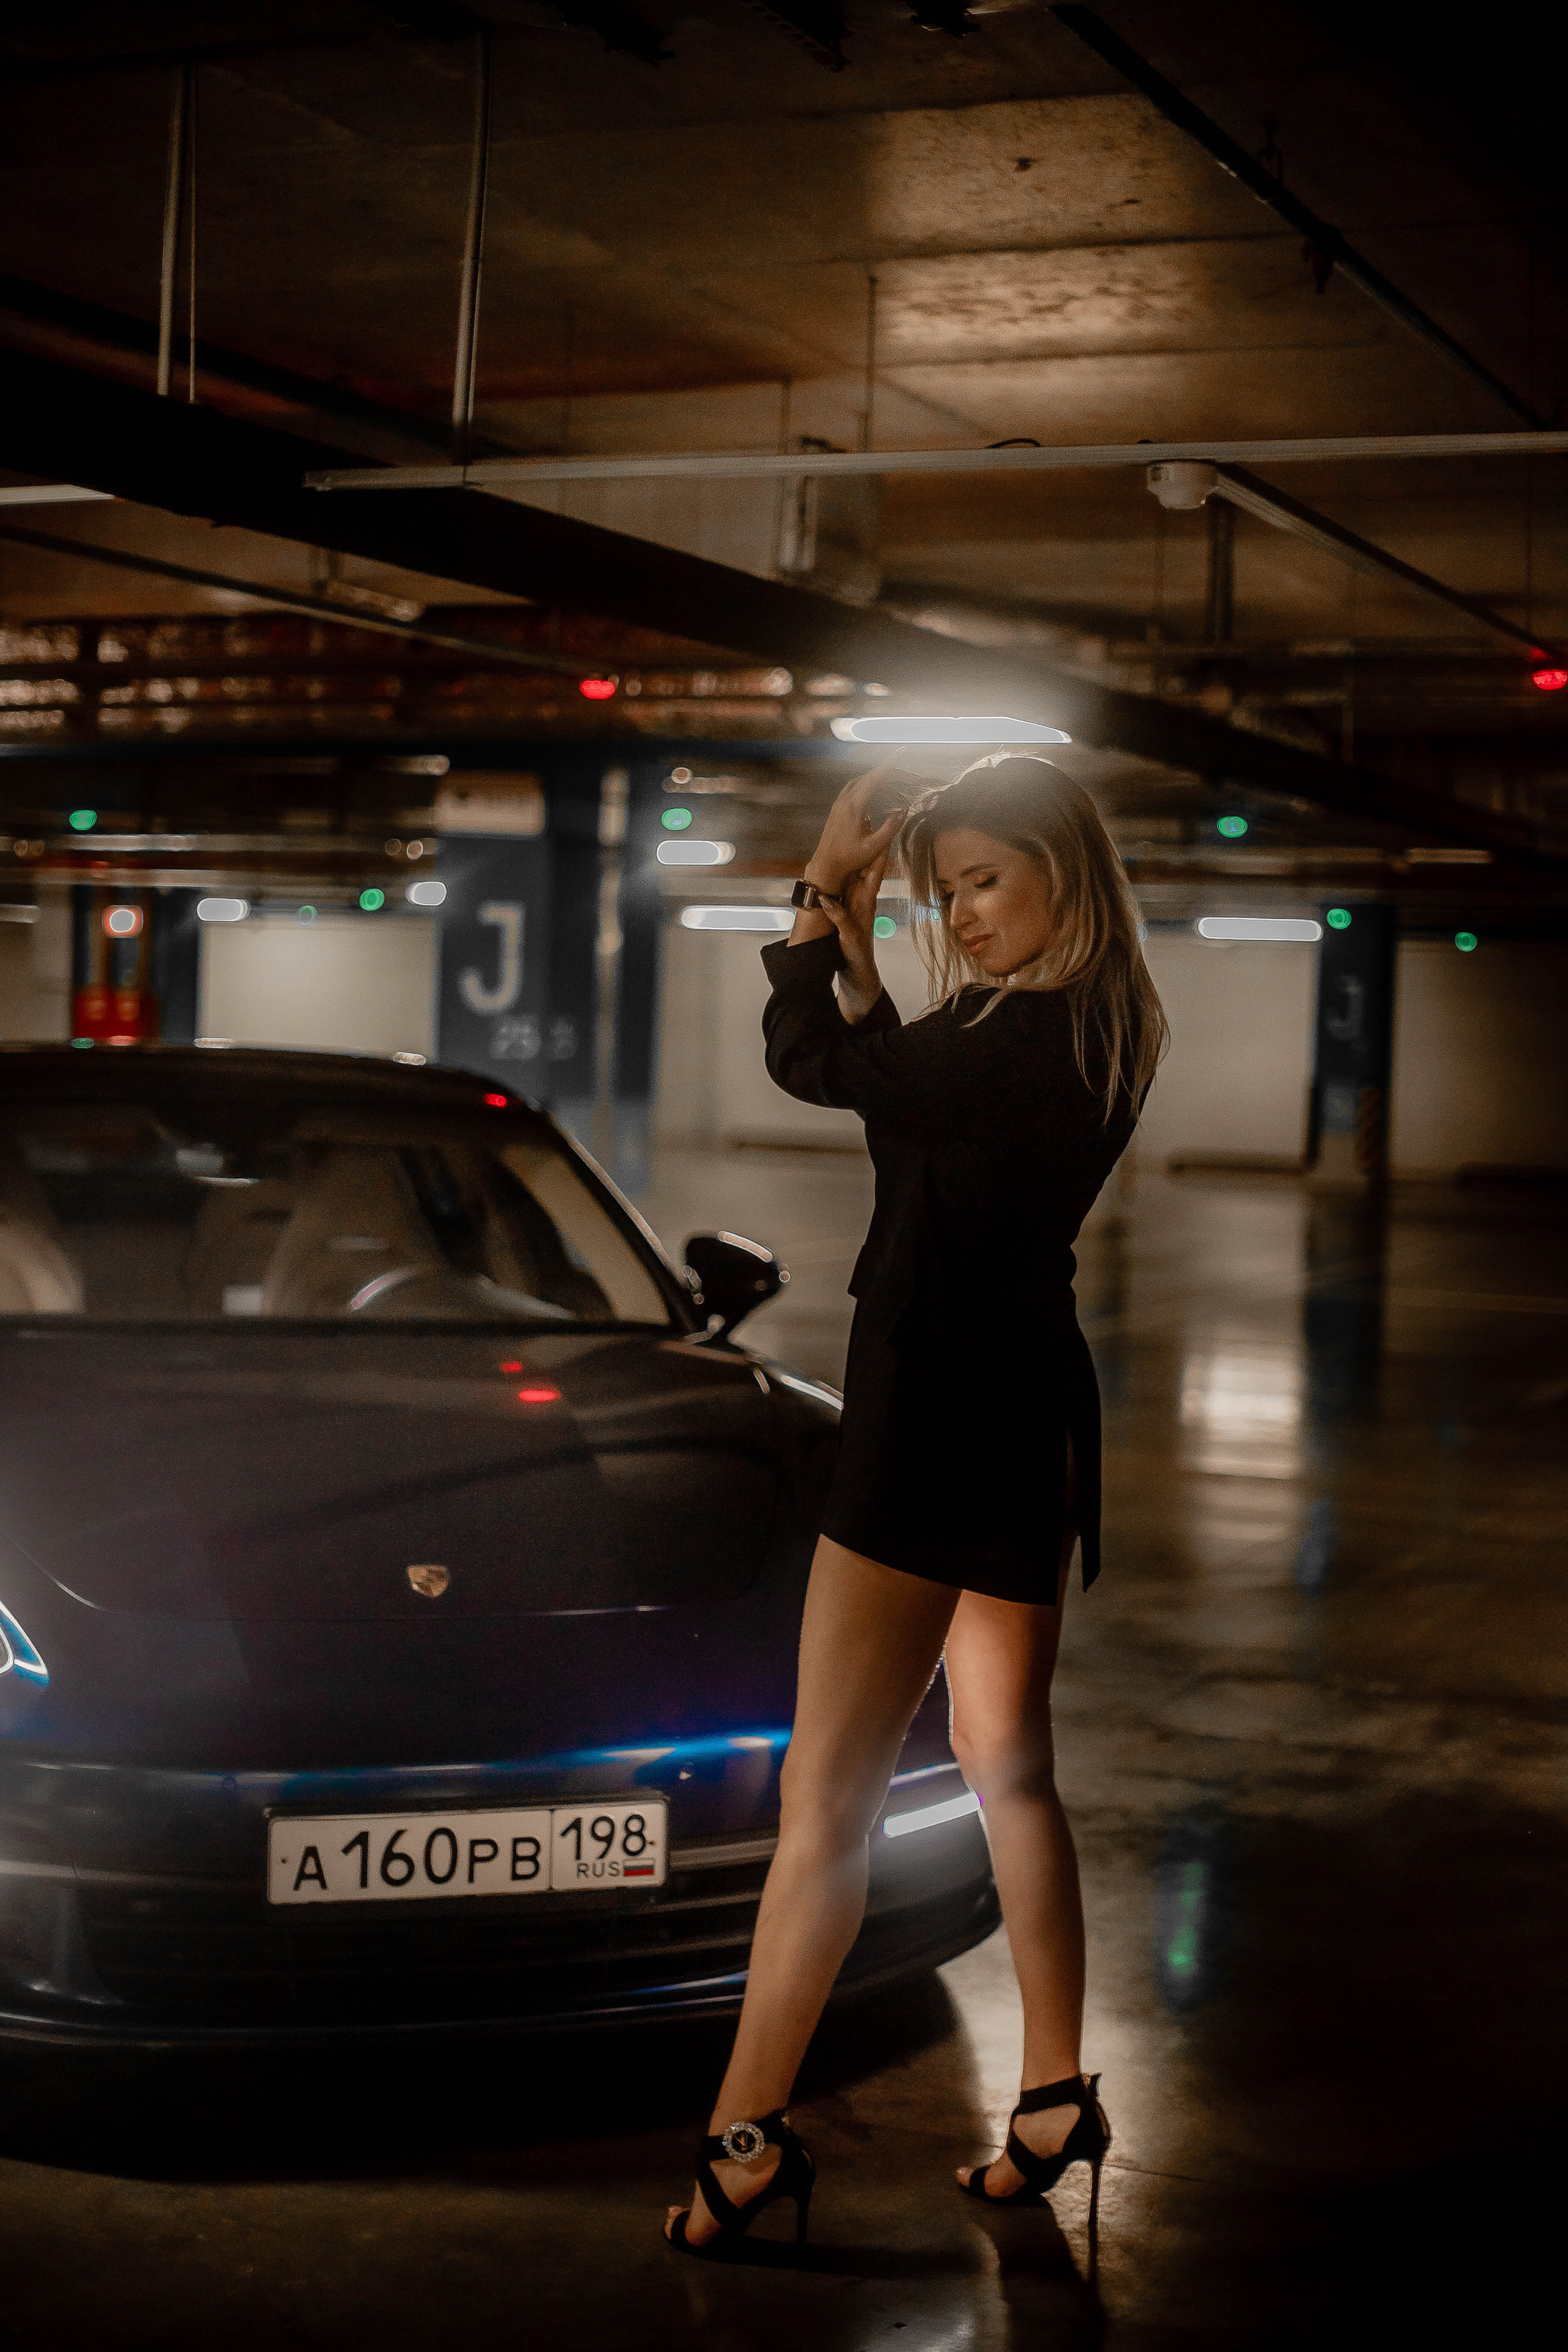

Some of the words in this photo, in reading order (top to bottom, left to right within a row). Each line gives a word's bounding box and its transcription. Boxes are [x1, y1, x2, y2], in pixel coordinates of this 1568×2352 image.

[460, 903, 524, 1012] J
[561, 1814, 646, 1860] 198
[576, 1861, 620, 1879] RUS
